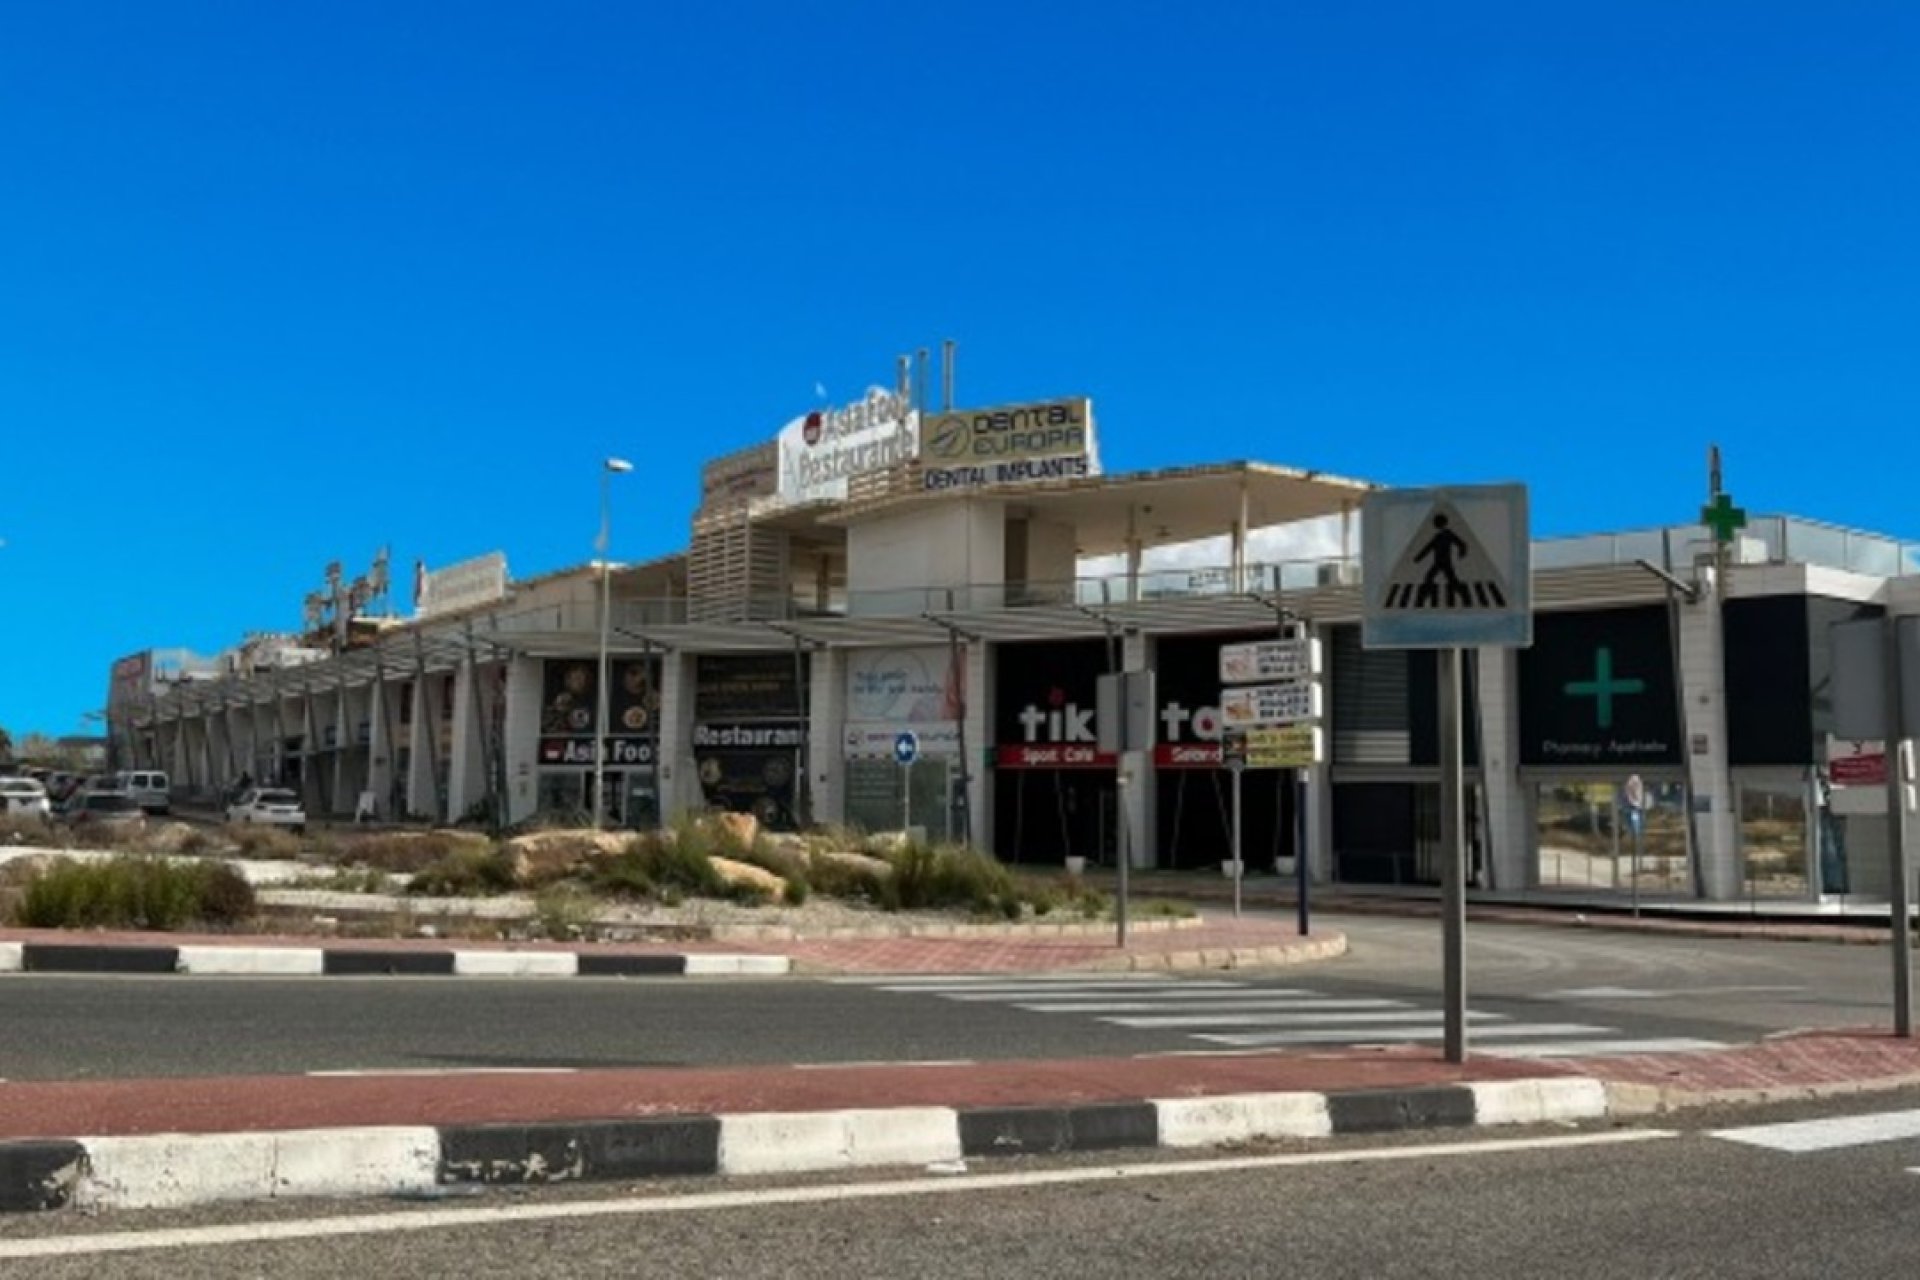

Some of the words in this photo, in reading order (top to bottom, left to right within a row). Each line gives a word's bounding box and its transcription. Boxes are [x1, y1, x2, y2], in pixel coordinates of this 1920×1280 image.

[925, 466, 986, 489] DENTAL
[996, 455, 1088, 482] IMPLANTS
[694, 725, 806, 745] Restauran
[614, 739, 658, 762] Foo
